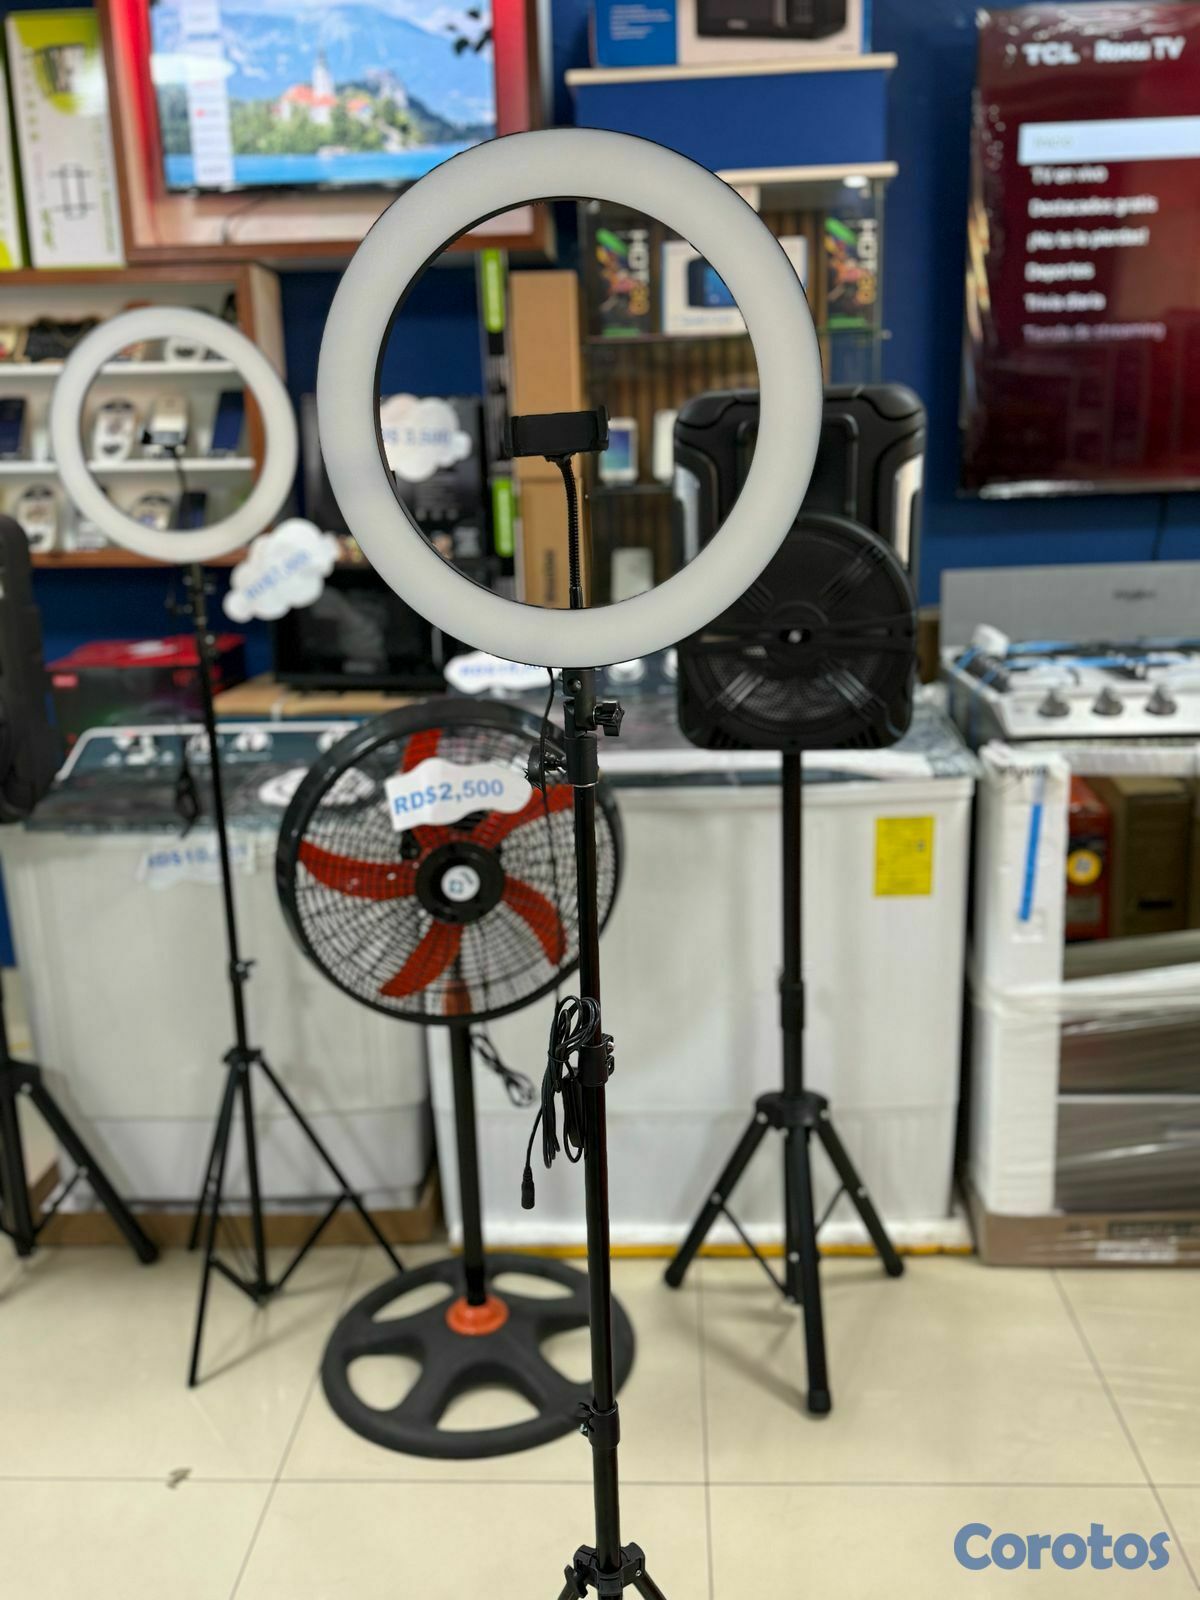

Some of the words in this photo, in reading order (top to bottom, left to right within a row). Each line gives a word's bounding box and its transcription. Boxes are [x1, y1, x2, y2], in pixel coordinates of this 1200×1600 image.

[1022, 41, 1081, 66] TCL
[1151, 35, 1187, 60] TV
[394, 778, 505, 815] RD$2,500
